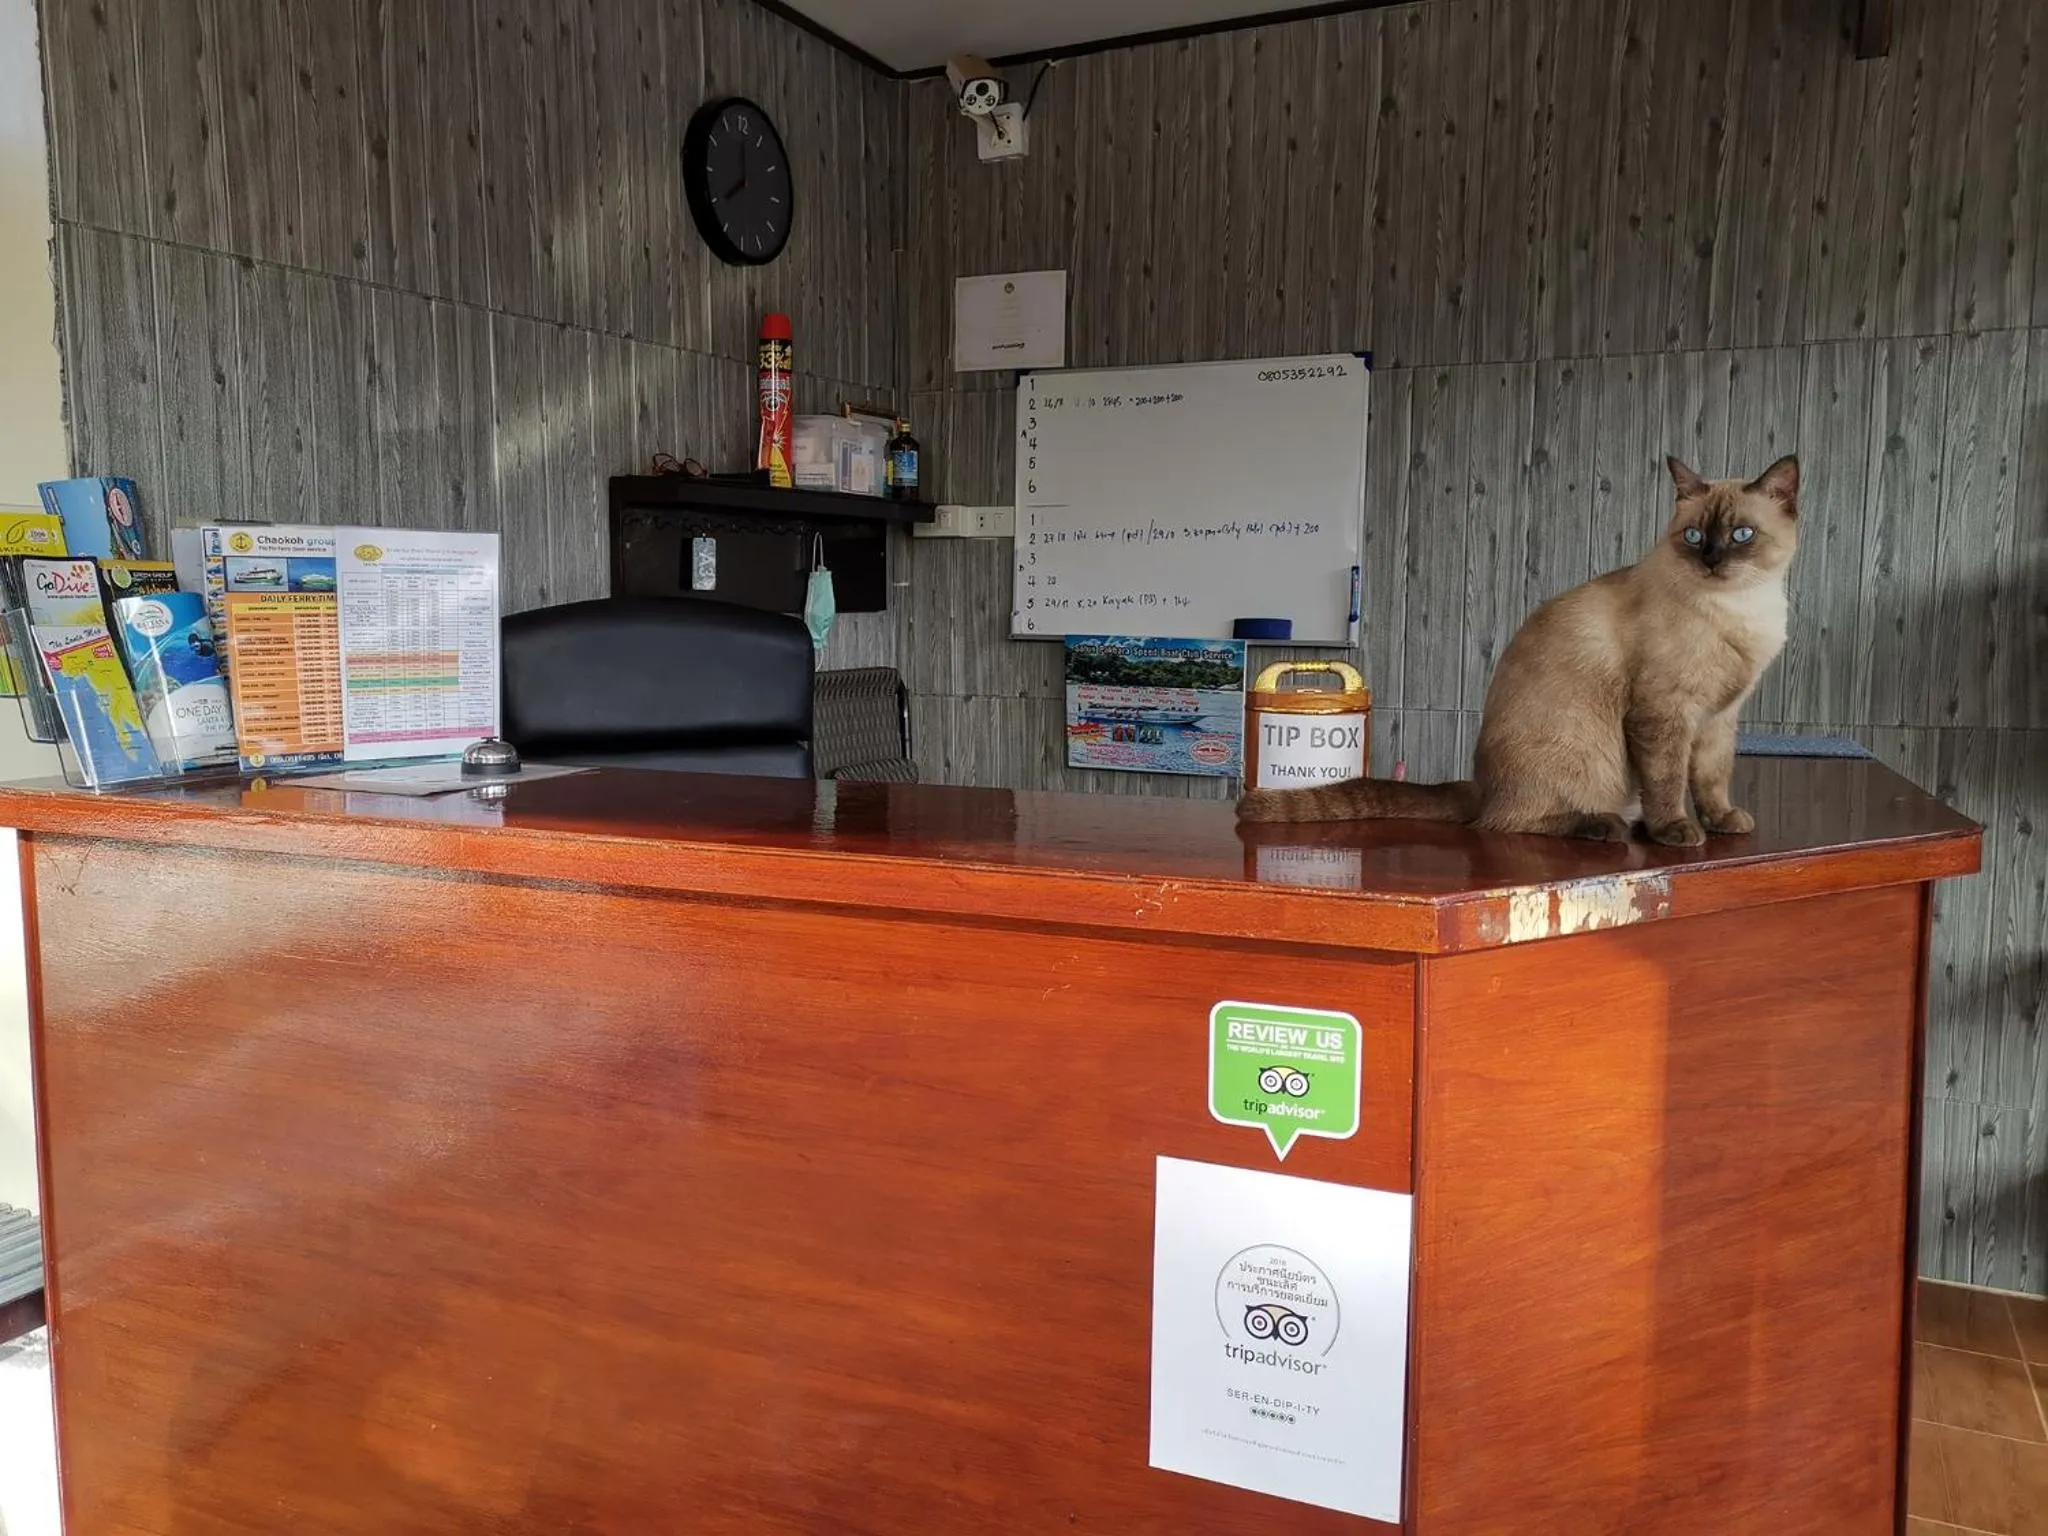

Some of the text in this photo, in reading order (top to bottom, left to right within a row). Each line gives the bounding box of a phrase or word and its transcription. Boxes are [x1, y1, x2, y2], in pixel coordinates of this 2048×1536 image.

[738, 115, 749, 135] 12
[1257, 364, 1348, 381] 0805352292
[1029, 378, 1035, 391] 1
[1028, 398, 1037, 410] 2
[1028, 417, 1037, 431] 3
[1028, 437, 1038, 451] 4
[1028, 456, 1037, 470] 5
[1028, 479, 1037, 493] 6
[1030, 513, 1035, 526] 1
[257, 535, 304, 545] Chaokoh
[1028, 532, 1036, 545] 2
[1028, 552, 1036, 565] 3
[1028, 575, 1037, 588] 4
[260, 594, 338, 603] DAILY FERRY TIM
[1026, 597, 1035, 610] 5
[1027, 617, 1035, 631] 6
[1133, 646, 1158, 657] Speed
[1203, 649, 1234, 660] Service
[175, 703, 223, 719] ONE DAY
[1264, 724, 1360, 749] TIP BOX
[1270, 764, 1352, 779] THANK YOU!
[1228, 1021, 1343, 1050] REVIEW US
[1243, 1098, 1321, 1120] tripadvisor
[1224, 1342, 1322, 1376] tripadvisor
[1226, 1388, 1321, 1416] SER-EN-DIP-I-TY
